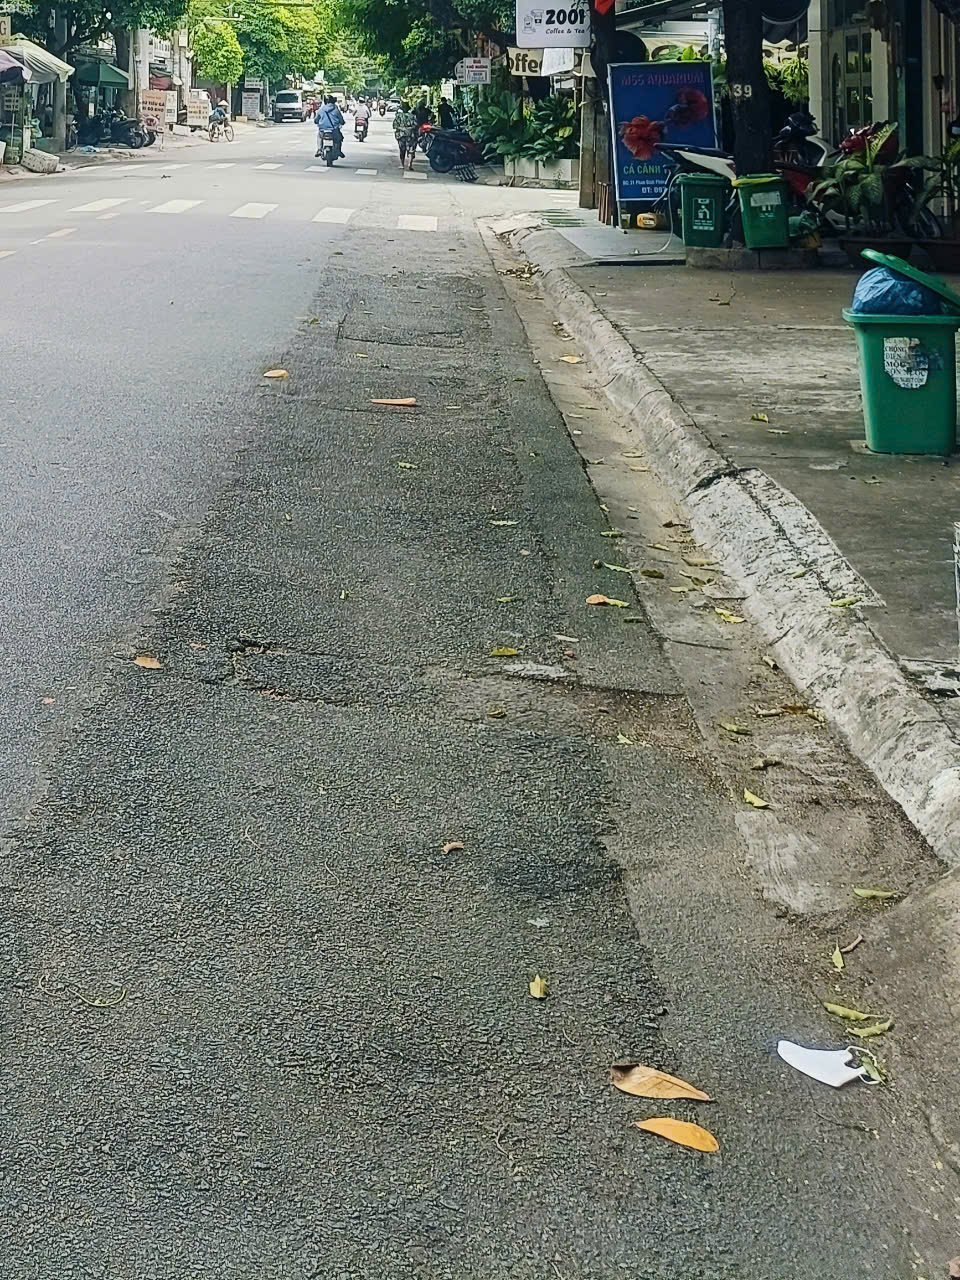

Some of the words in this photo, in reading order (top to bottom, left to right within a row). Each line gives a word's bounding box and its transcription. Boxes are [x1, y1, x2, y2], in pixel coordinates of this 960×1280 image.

[733, 84, 752, 98] 39
[623, 163, 635, 175] CÁ
[637, 163, 661, 175] CẢNH
